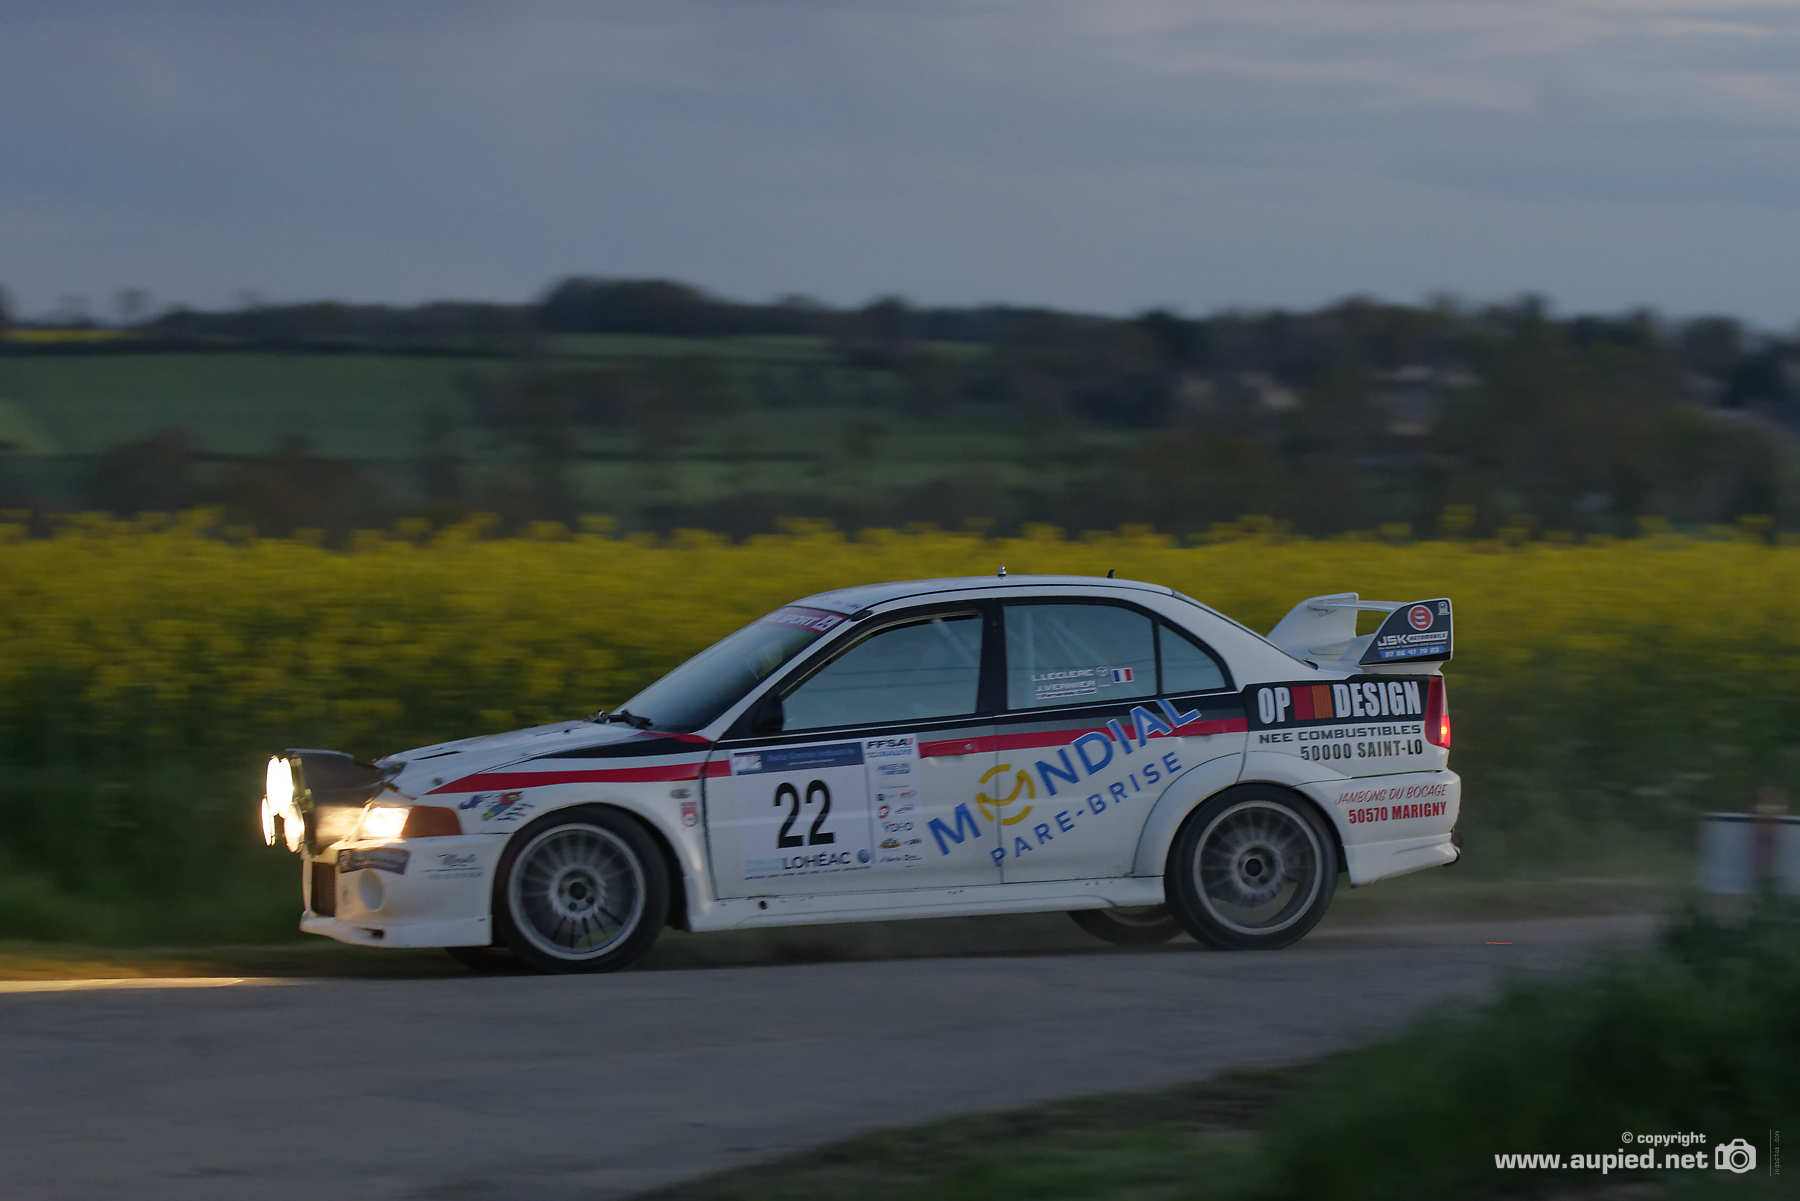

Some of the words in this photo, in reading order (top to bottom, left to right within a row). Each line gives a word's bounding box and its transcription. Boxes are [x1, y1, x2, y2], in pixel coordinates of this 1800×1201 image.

[1377, 634, 1407, 647] JSK
[1257, 686, 1292, 725] OP
[1332, 680, 1422, 718] DESIGN
[866, 738, 907, 750] FFSA
[1259, 732, 1294, 745] NEE
[1297, 724, 1422, 742] COMBUSTIBLES
[1300, 743, 1353, 762] 50000
[1356, 738, 1423, 759] SAINT-LO
[1336, 788, 1387, 806] JAMBONS
[1388, 786, 1404, 801] DU
[1405, 783, 1449, 800] BOCAGE
[774, 779, 836, 850] 22
[990, 751, 1183, 868] PARE-BRISE
[1348, 806, 1389, 825] 50570
[1391, 801, 1448, 821] MARIGNY
[782, 850, 852, 871] LOHÉAC
